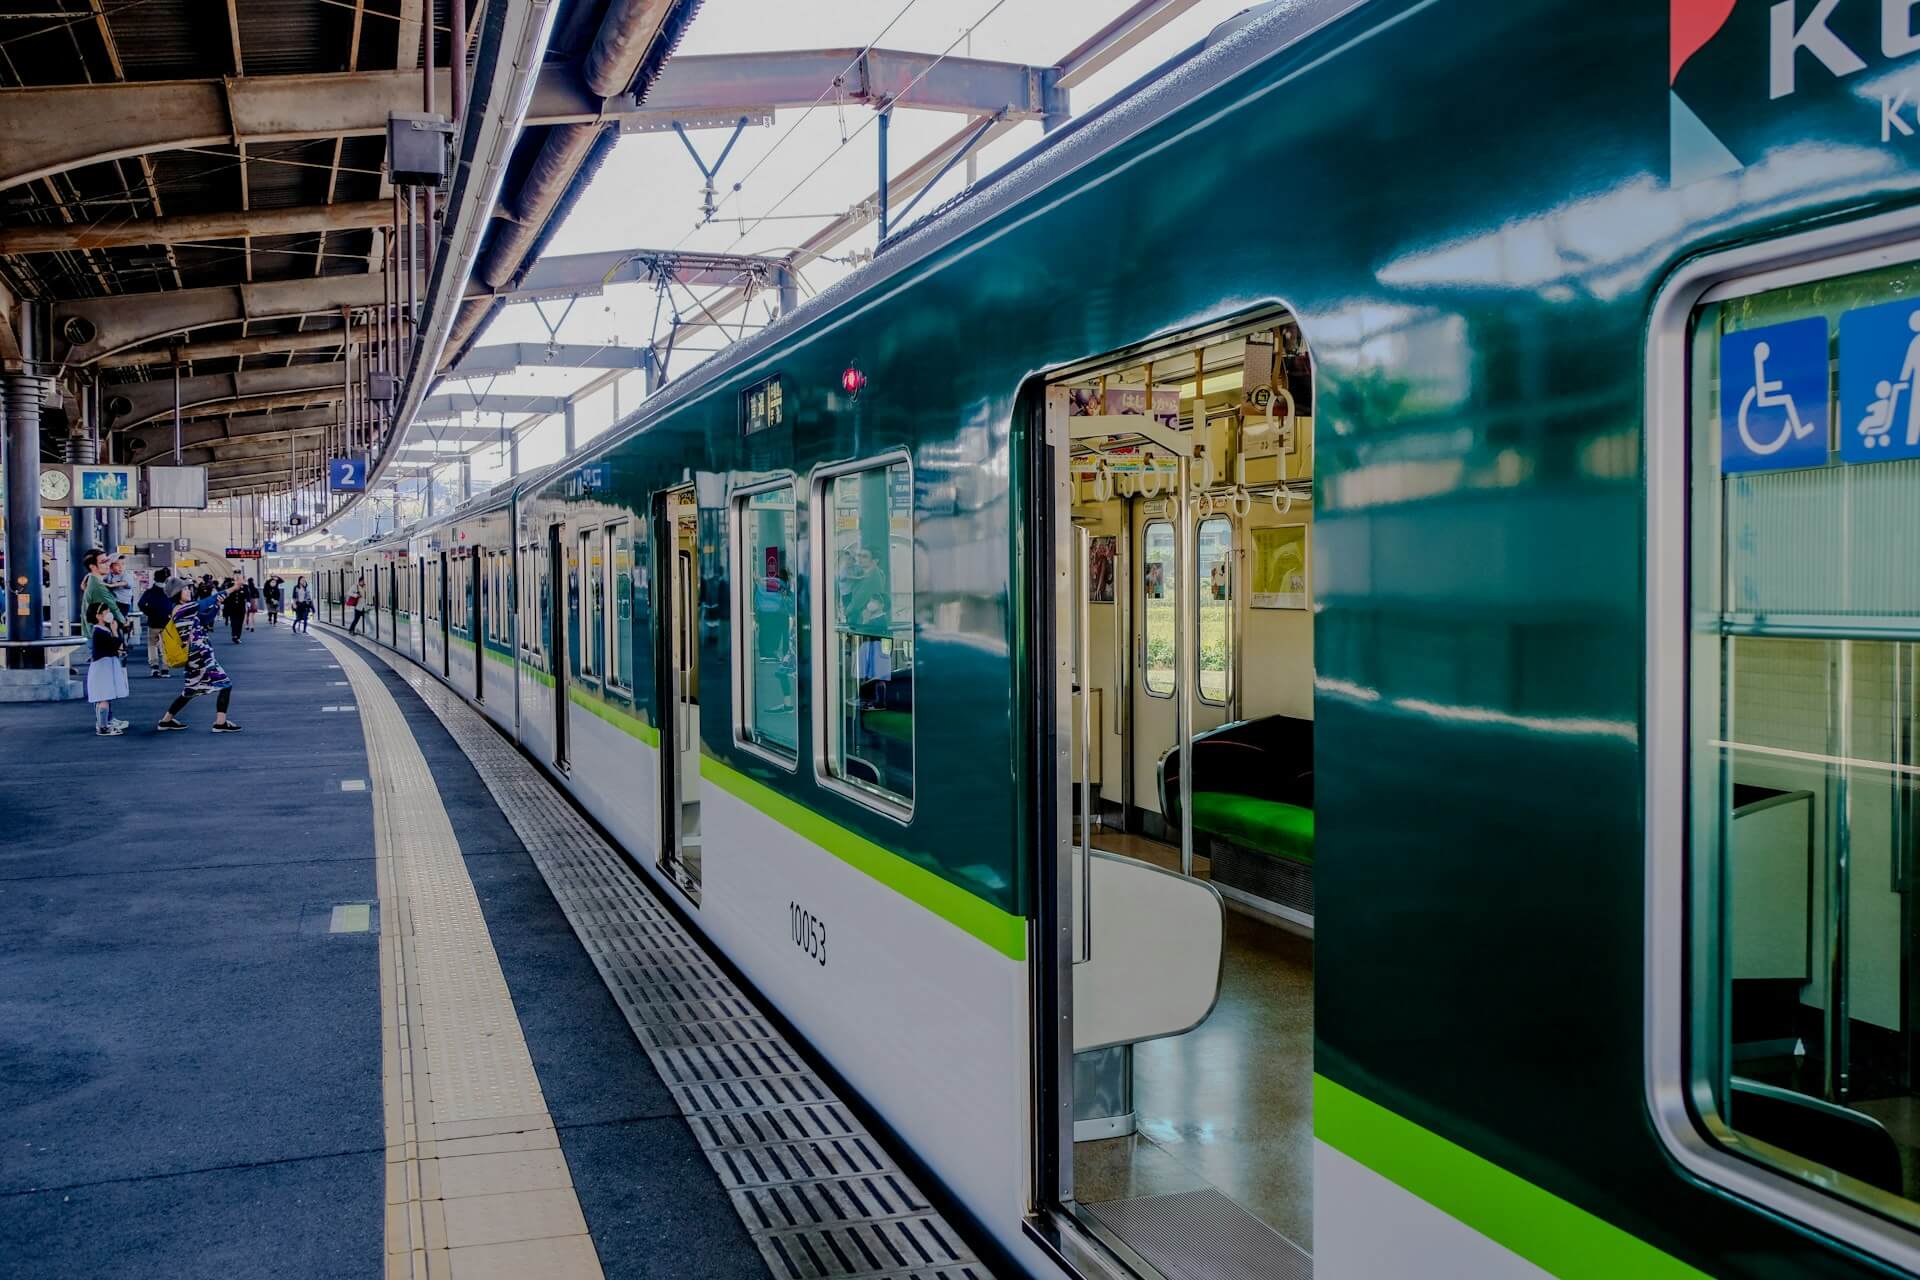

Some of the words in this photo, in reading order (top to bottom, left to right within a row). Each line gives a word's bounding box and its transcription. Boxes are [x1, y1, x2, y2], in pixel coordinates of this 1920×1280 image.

[1881, 88, 1920, 142] K
[341, 463, 355, 485] 2
[267, 542, 274, 550] 2
[790, 900, 826, 966] 10053
